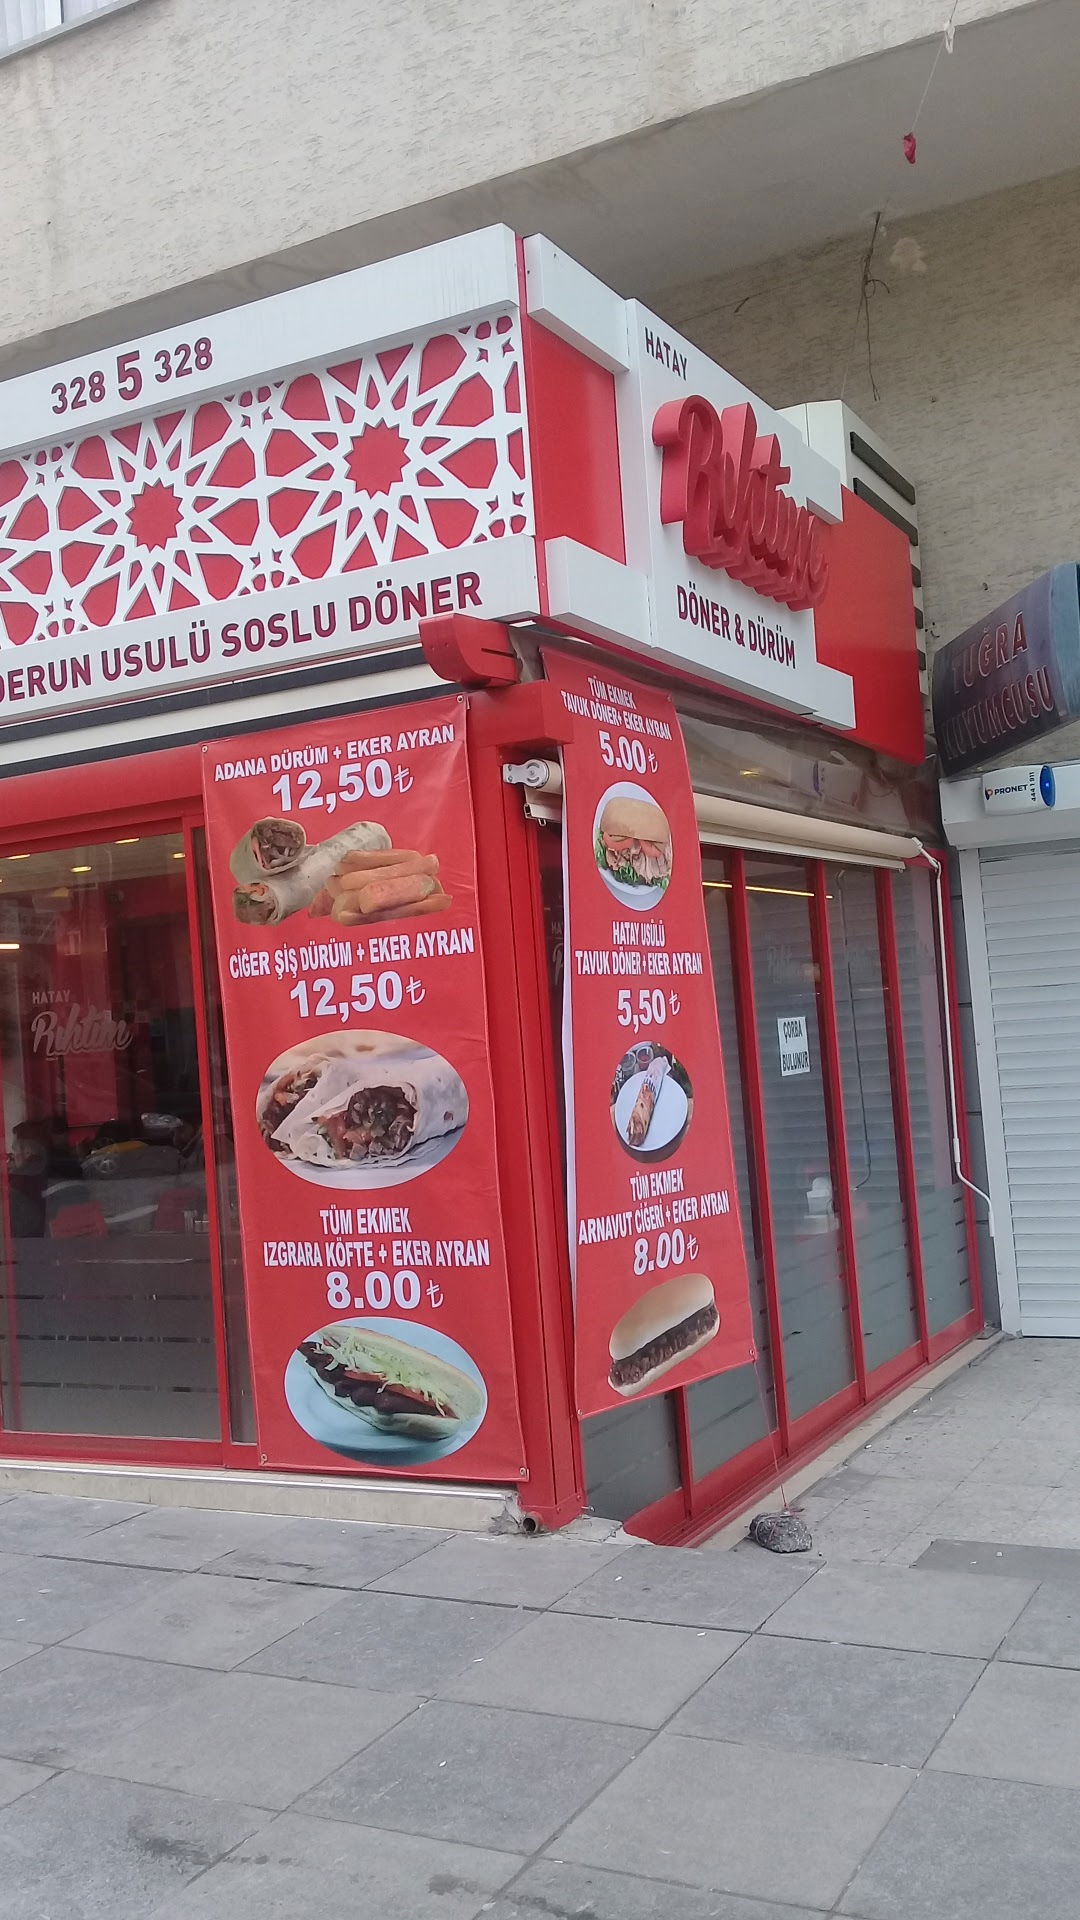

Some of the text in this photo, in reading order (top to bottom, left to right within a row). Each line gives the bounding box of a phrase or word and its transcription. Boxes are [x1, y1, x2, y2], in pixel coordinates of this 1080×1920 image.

[645, 326, 687, 381] HATAY
[51, 337, 213, 414] 328 5 328
[0, 571, 483, 703] ERUN USULÜ SOSLU DÖNER
[677, 580, 796, 669] DÖNER & DÜRÜM
[951, 611, 1029, 695] TUĞRA
[607, 684, 637, 710] EKMEK
[560, 690, 591, 718] TAVUK
[623, 711, 646, 734] EKER
[645, 717, 672, 741] AYRAN
[214, 759, 267, 782] ADANA
[270, 745, 329, 773] DÜRÜM
[347, 735, 392, 760] EKER
[396, 723, 455, 751] AYRAN
[994, 784, 1028, 796] PRONET
[612, 920, 640, 946] HATAY
[229, 947, 271, 979] CİĞER
[274, 943, 298, 981] ŞİŞ
[301, 938, 353, 972] DÜRÜM
[368, 934, 412, 964] EKER
[415, 927, 475, 959] AYRAN
[574, 950, 611, 975] TAVUK
[612, 946, 641, 975] DÖNER
[648, 952, 671, 975] EKER
[672, 952, 703, 975] AYRAN
[32, 989, 71, 1005] HATAY
[783, 1020, 803, 1044] ÇORBA
[782, 1051, 809, 1072] BULUNUR
[629, 1168, 685, 1202] TÜM EKMEK
[319, 1204, 413, 1235] TÜM EKMEK
[578, 1211, 633, 1246] ARNAVUT
[634, 1198, 665, 1234] CİĞERİ
[672, 1197, 699, 1225] EKER
[700, 1190, 730, 1219] AYRAN
[263, 1240, 323, 1267] IZGRARA
[325, 1236, 375, 1268] KÖFTE
[391, 1239, 433, 1267] EKER
[435, 1239, 490, 1267] AYRAN
